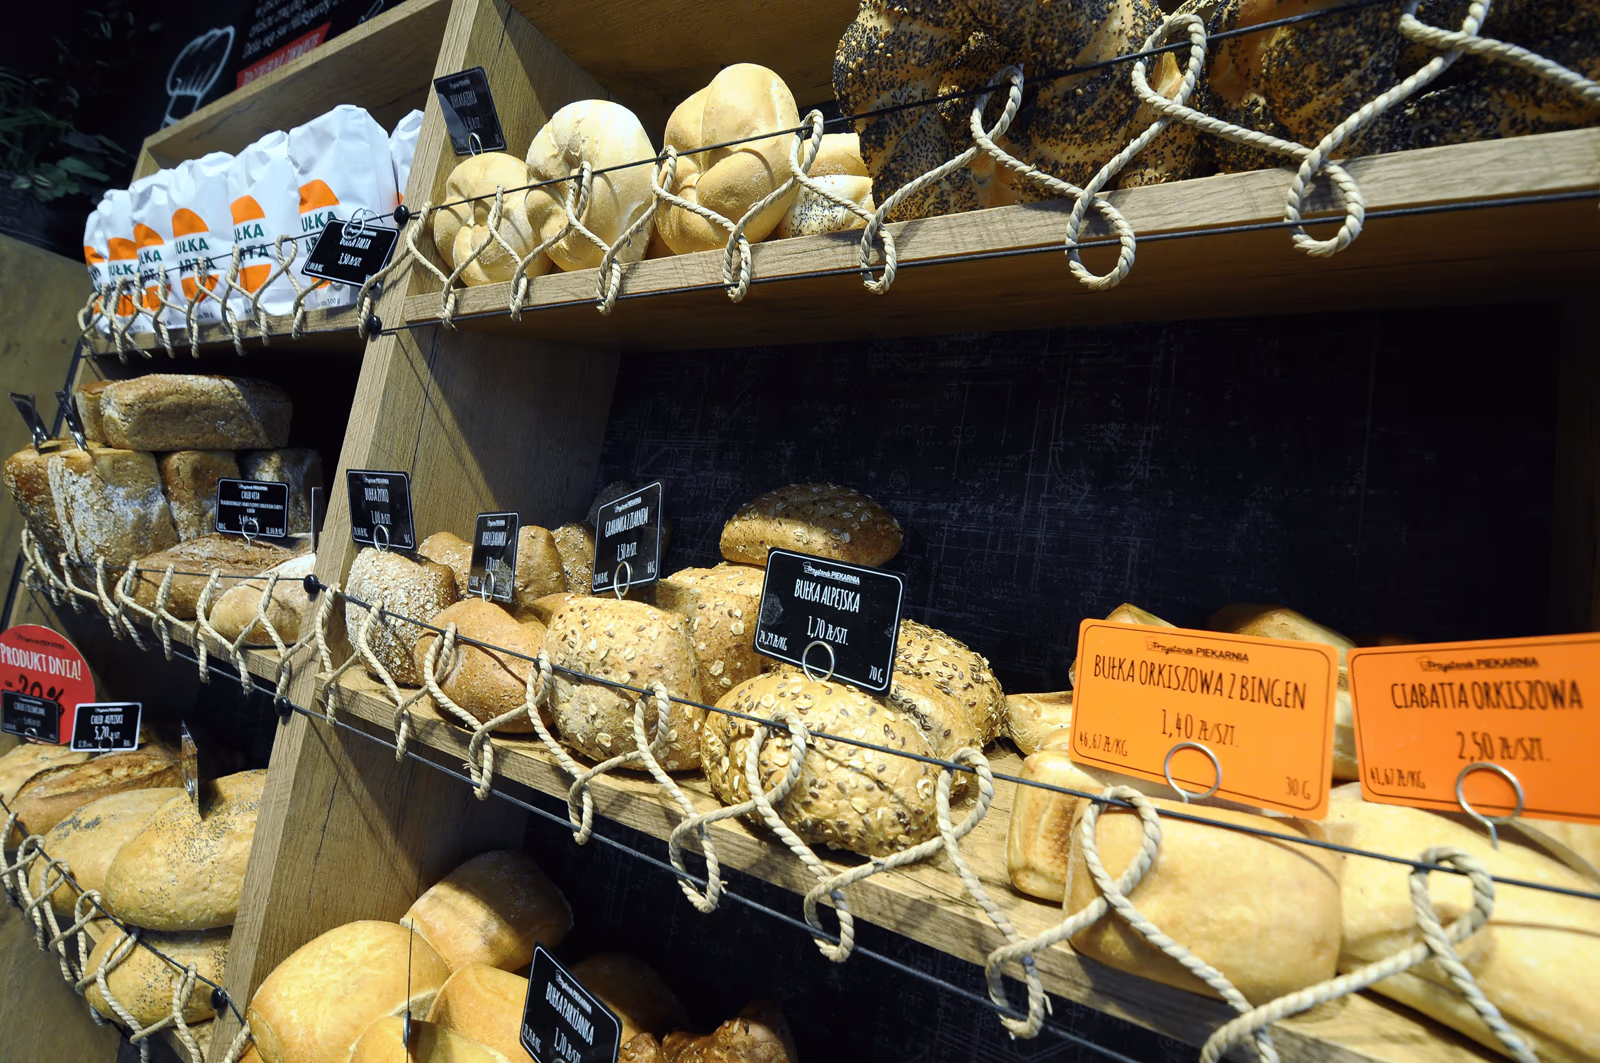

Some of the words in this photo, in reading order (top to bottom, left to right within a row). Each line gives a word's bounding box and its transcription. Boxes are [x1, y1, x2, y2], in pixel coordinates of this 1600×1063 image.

[234, 223, 264, 243] UŁKA
[301, 211, 337, 232] UŁKA
[176, 238, 209, 255] UŁKA
[794, 579, 820, 603] BUŁKA
[820, 585, 860, 613] ALPEJSKA
[807, 615, 826, 639] 1,70
[0, 643, 47, 672] PRODUKT
[48, 655, 82, 681] DNIA!
[1196, 647, 1249, 662] PIEKARNIA
[1475, 657, 1540, 669] PIEKARNIA
[868, 665, 878, 681] 70
[1094, 654, 1135, 683] BUŁKA
[1139, 660, 1223, 697] ORKISZOWA
[1228, 673, 1236, 700] Z
[1240, 675, 1307, 710] BINGEN
[1391, 682, 1469, 709] CIABATTA
[1471, 679, 1584, 710] ORKISZOWA
[1161, 709, 1194, 740] 1,40
[1079, 731, 1103, 750] 46,67
[1456, 731, 1495, 763] 2,50
[1286, 776, 1299, 796] 30
[1302, 780, 1311, 800] G
[545, 981, 564, 1014] BUŁKA
[562, 997, 595, 1046] PARYŻANKA
[554, 1027, 568, 1056] 1,70
